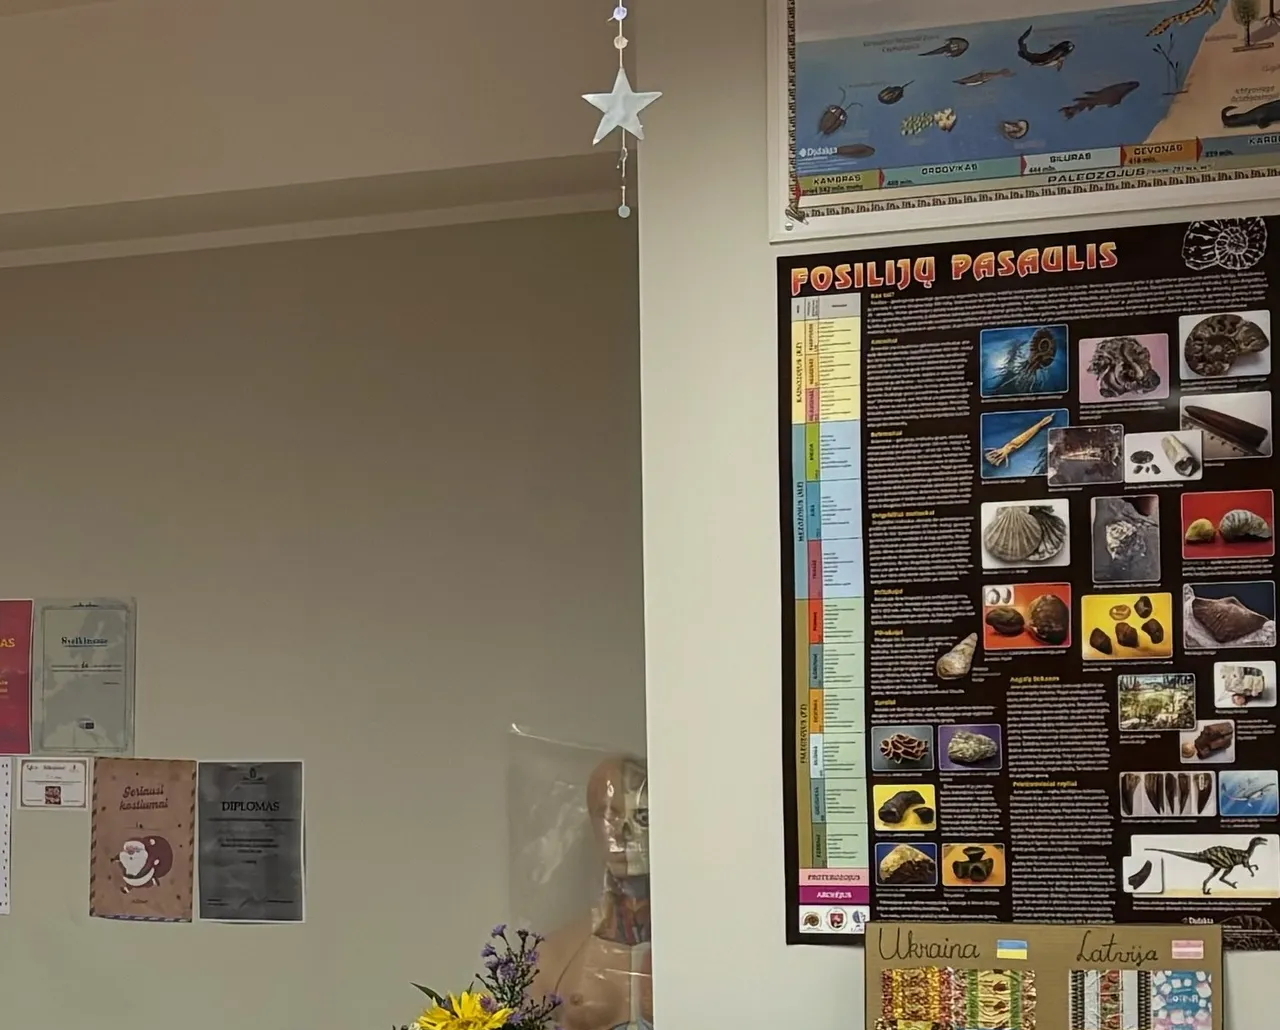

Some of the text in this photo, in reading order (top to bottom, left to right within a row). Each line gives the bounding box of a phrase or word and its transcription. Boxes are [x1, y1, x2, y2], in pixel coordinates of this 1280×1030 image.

[1249, 136, 1280, 145] KARB
[1047, 168, 1145, 183] PALEOZOJUS
[791, 241, 1118, 295] FOSILIJŲ PASAULIS
[221, 801, 280, 811] DIPLOMAS
[878, 927, 981, 960] Ukraina
[1076, 930, 1159, 966] Latvija
